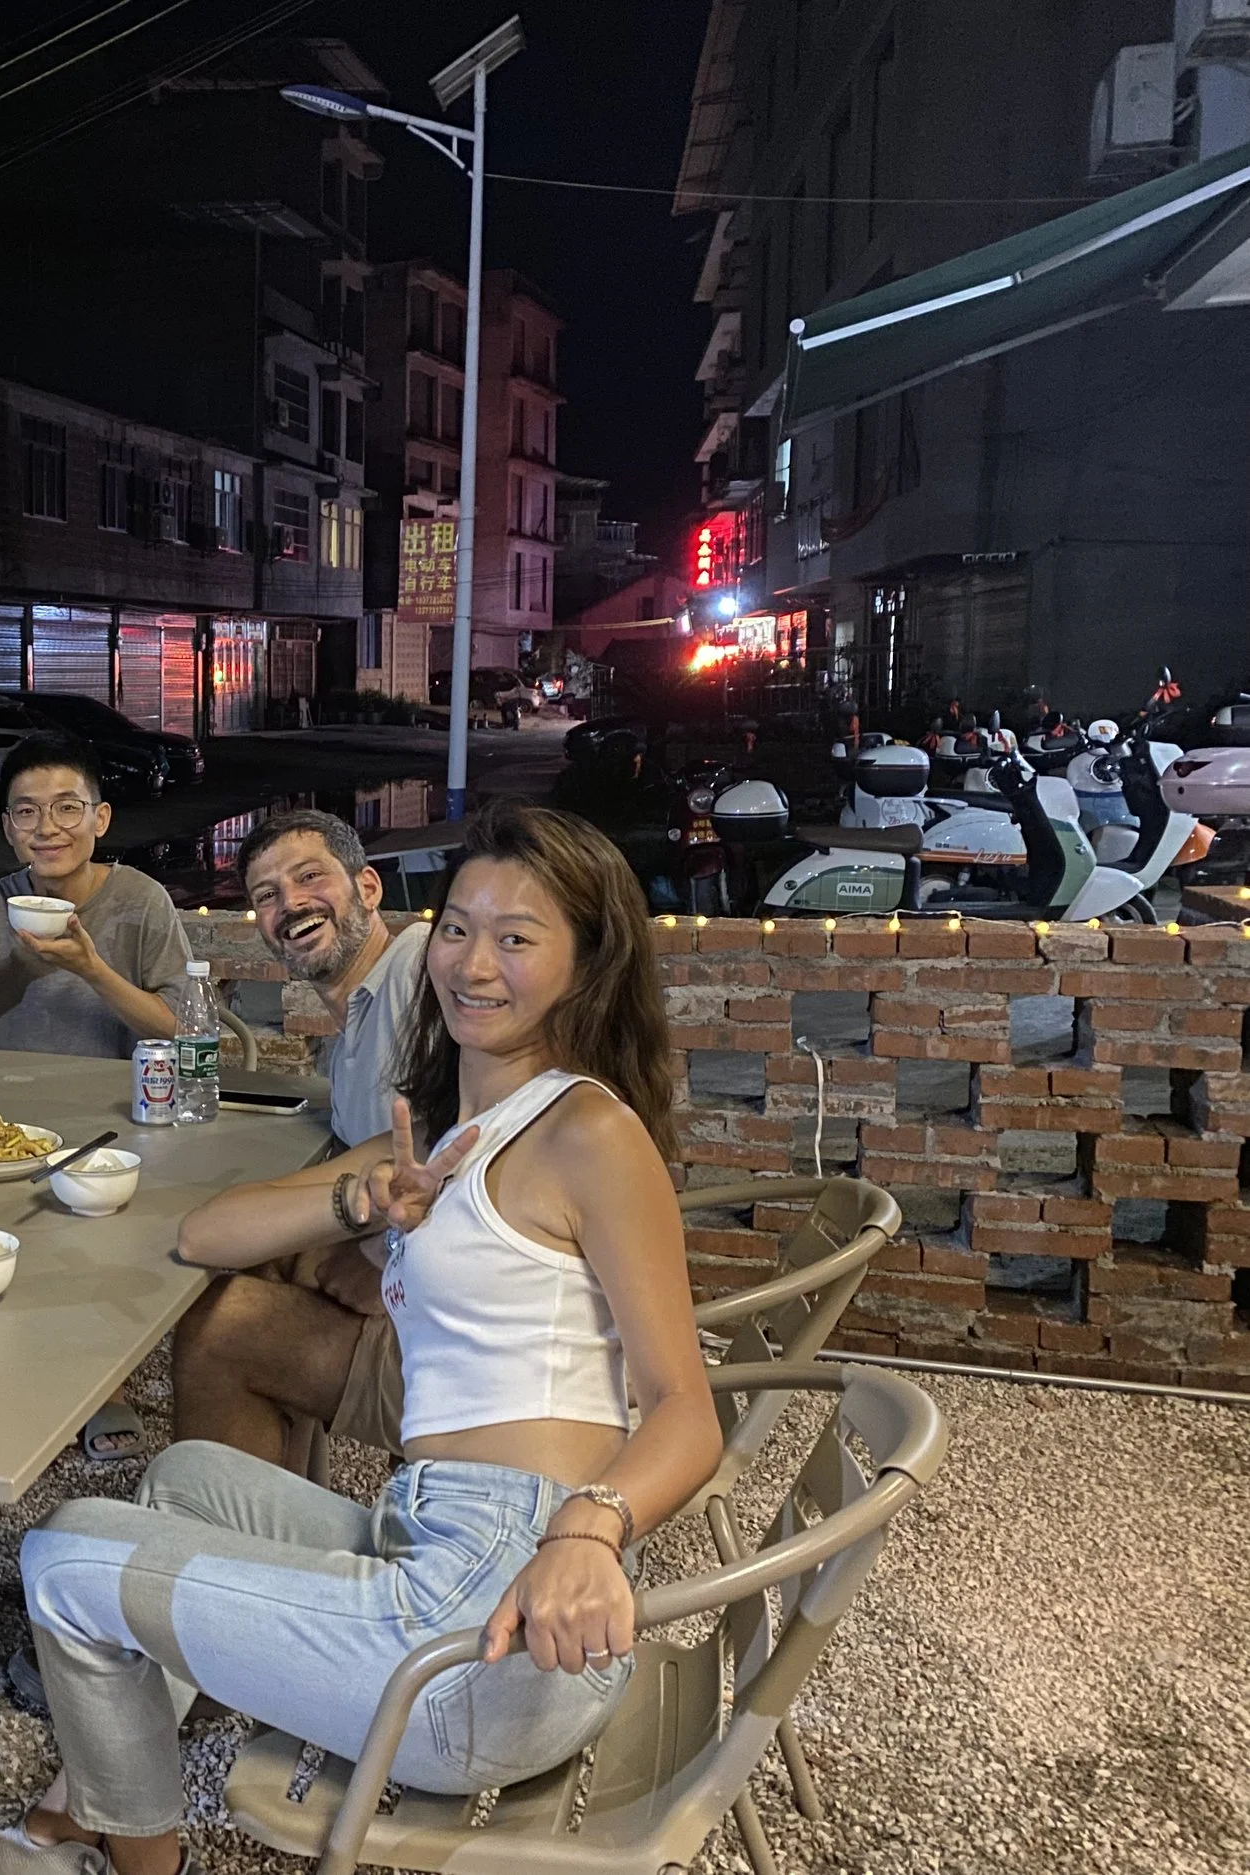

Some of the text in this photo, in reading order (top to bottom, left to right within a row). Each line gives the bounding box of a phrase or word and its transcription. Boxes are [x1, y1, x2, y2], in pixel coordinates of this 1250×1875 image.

[403, 522, 455, 554] 出租
[405, 557, 452, 573] 电动车
[405, 576, 452, 591] 自行车
[838, 884, 871, 895] AIMA
